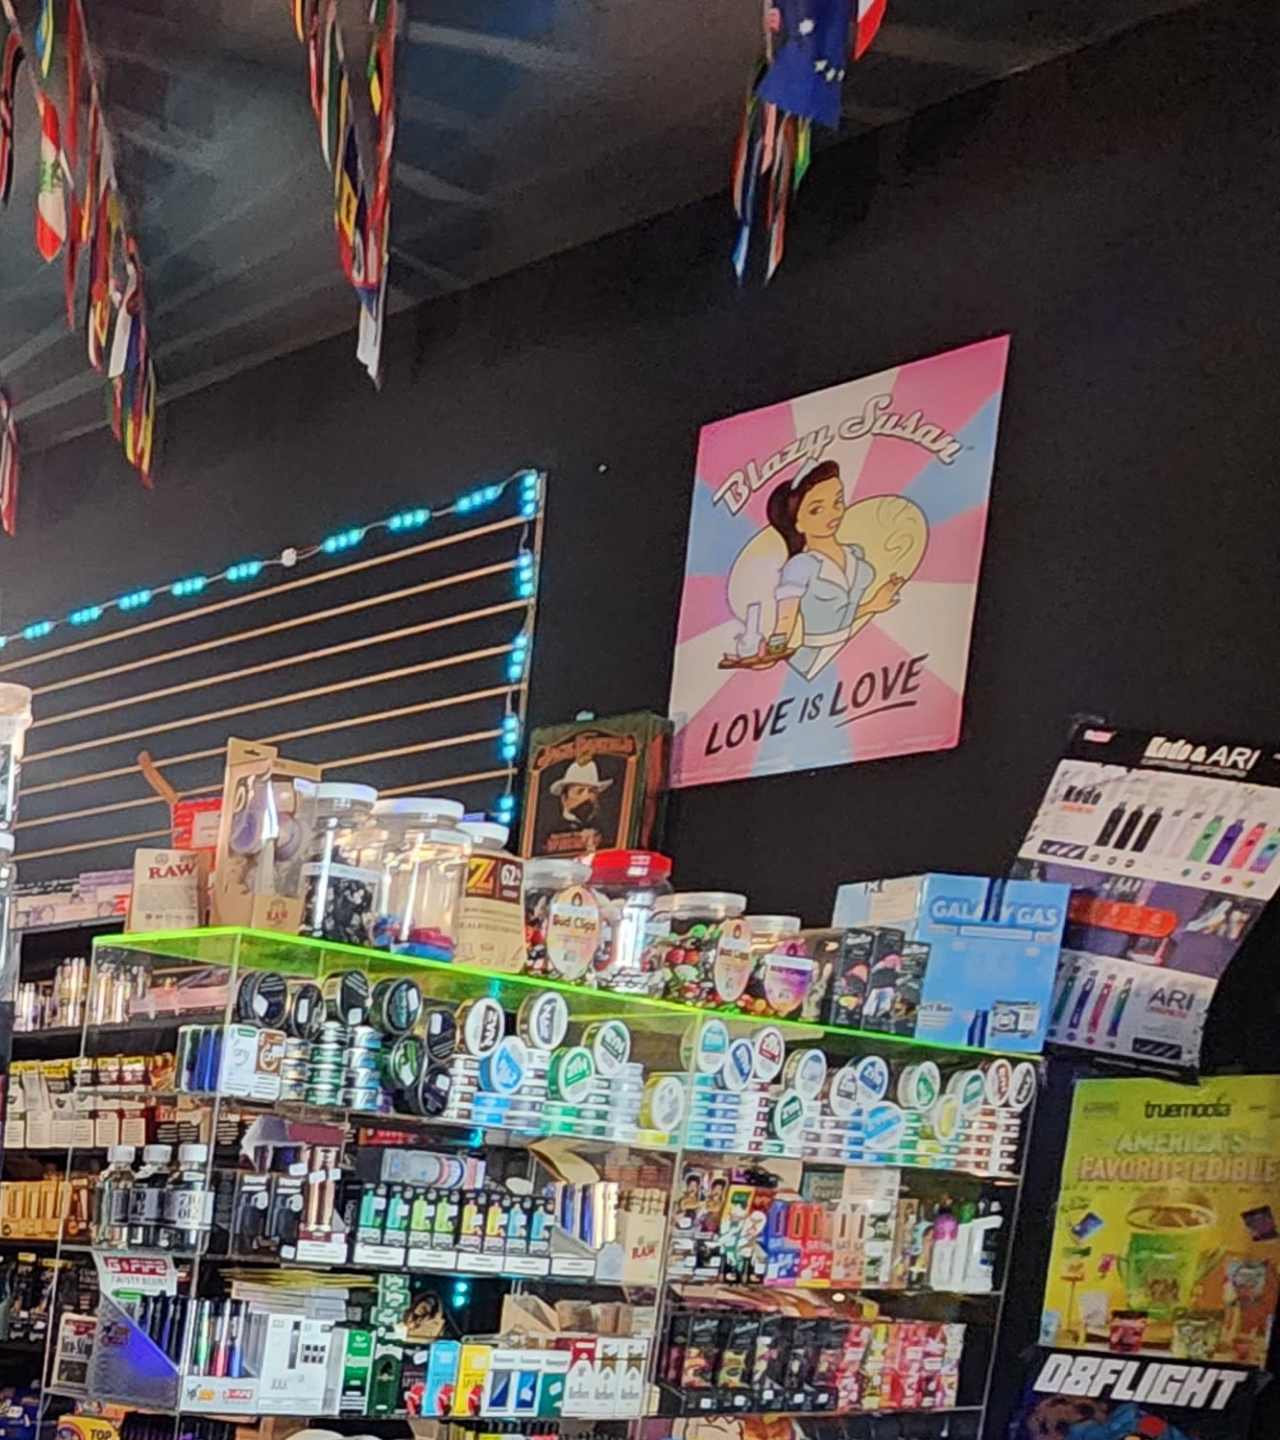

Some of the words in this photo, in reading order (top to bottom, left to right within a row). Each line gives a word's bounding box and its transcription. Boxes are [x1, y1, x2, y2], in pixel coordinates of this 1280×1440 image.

[712, 424, 834, 516] Blazy
[839, 394, 966, 464] Susan
[705, 696, 795, 757] LOVE
[798, 693, 823, 723] IS
[827, 653, 931, 718] LOVE
[1205, 745, 1261, 771] ARI
[148, 862, 197, 880] RAW
[552, 912, 571, 928] Bud
[1016, 905, 1059, 927] GAS
[1147, 987, 1196, 1011] ARI
[1078, 1155, 1185, 1182] FAVORITE
[1034, 1354, 1247, 1410] D8FLIGHT
